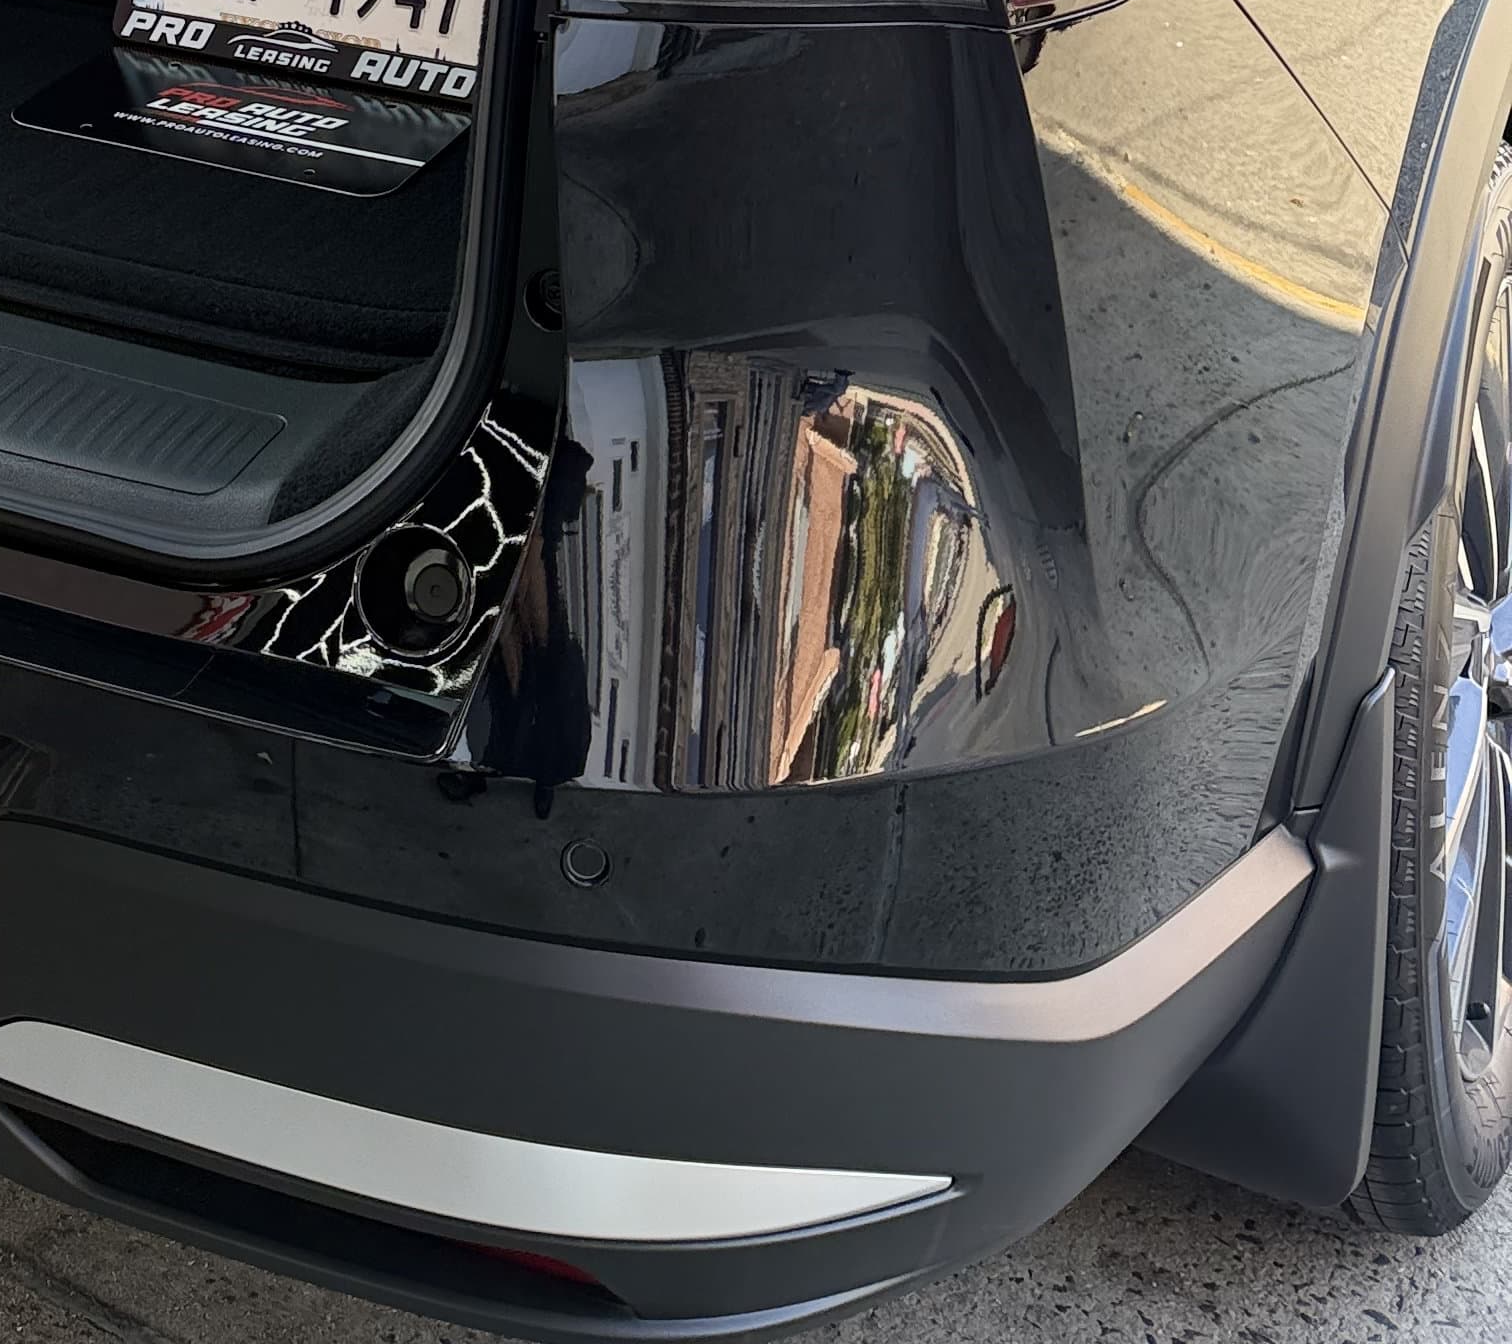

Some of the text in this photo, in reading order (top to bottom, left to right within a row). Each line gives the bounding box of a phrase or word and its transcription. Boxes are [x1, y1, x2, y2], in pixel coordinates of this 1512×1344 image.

[120, 10, 217, 51] PRO
[233, 44, 331, 73] LEASING
[350, 51, 477, 98] AUTO
[145, 97, 317, 138] LEASING
[158, 87, 349, 130] PRO AUTO
[113, 111, 324, 159] WWW.PROAUTOLEASING.COM
